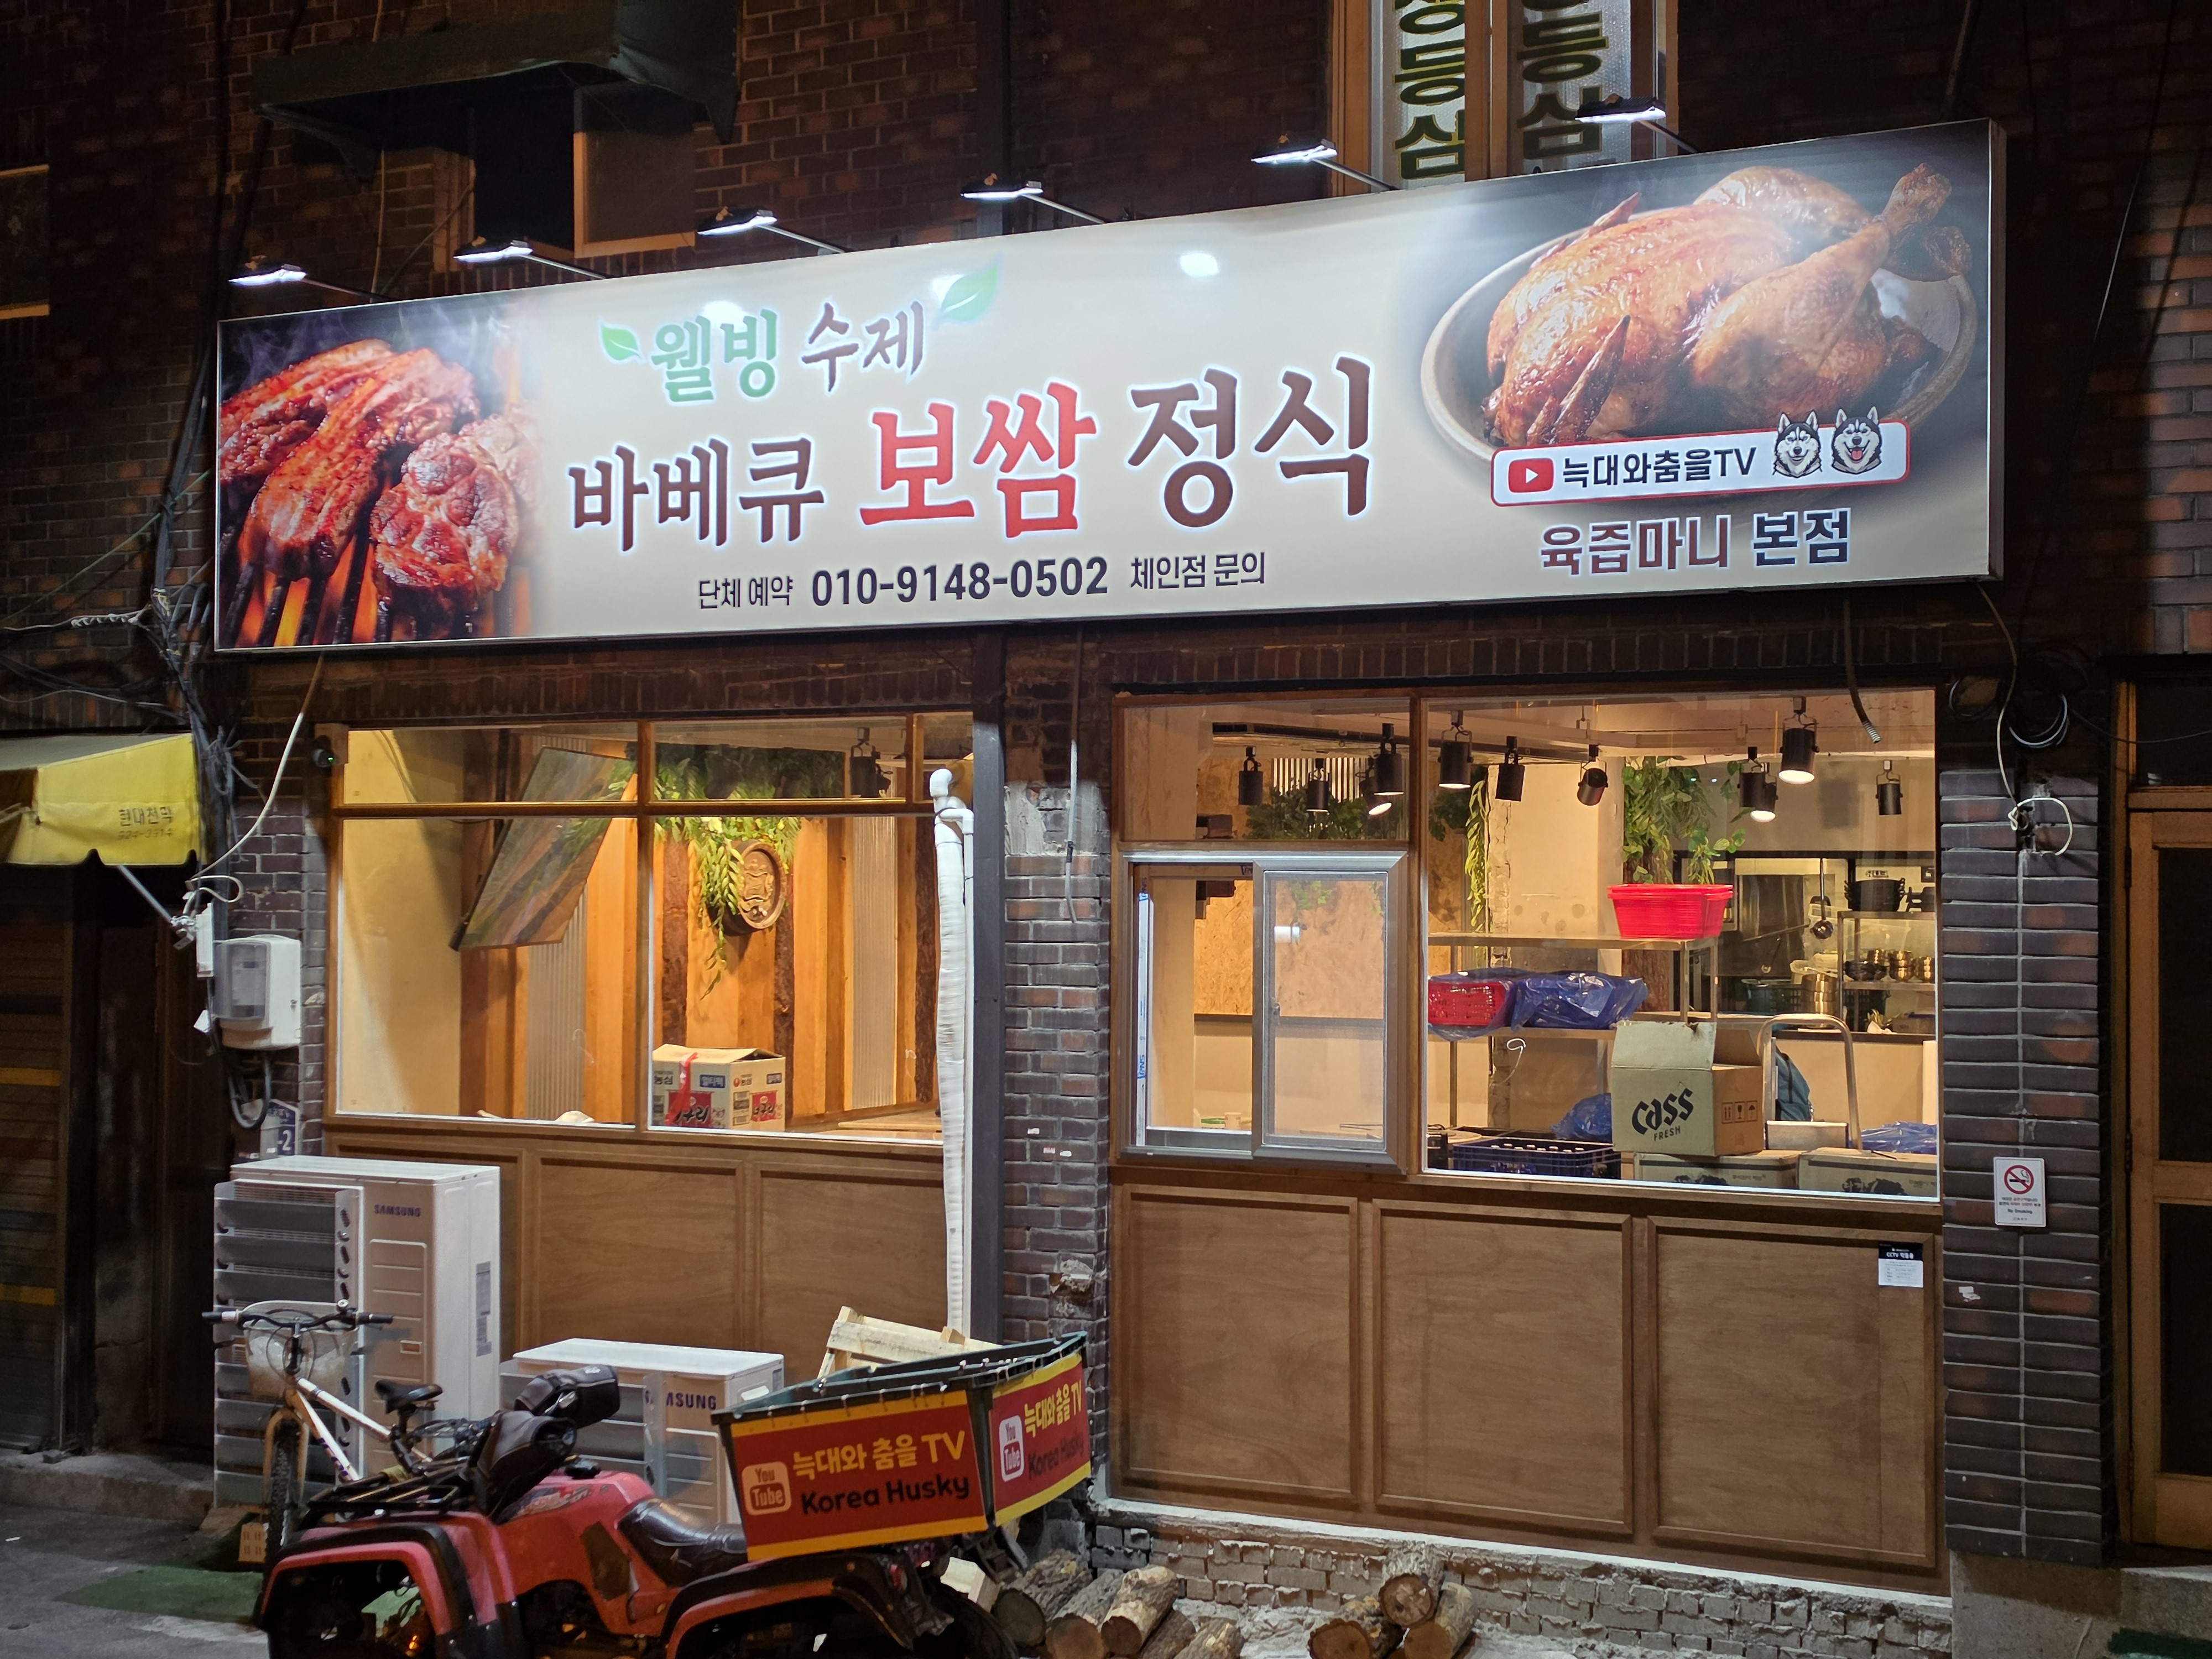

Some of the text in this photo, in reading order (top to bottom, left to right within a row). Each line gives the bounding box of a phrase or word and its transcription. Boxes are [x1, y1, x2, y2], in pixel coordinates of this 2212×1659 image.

[651, 300, 924, 402] 웰빙 수제
[568, 357, 1370, 552] 바베큐 보쌈 정식
[1562, 447, 1756, 488] 늑대와춤을TV
[1541, 508, 1851, 576] 육즙마니 본점
[698, 551, 1265, 609] 단체 예약 010-9148-0502 체인점 문의
[1653, 1125, 1681, 1141] FRESH
[374, 1204, 421, 1217] SAMSUNG
[1024, 1379, 1082, 1438] 늑대와 춤을 TV
[755, 1468, 775, 1483] You
[793, 1430, 966, 1480] 늑대와 춤을 TV
[1004, 1448, 1021, 1470] Tube
[752, 1486, 784, 1507] Tube
[801, 1474, 970, 1515] Korea Husky
